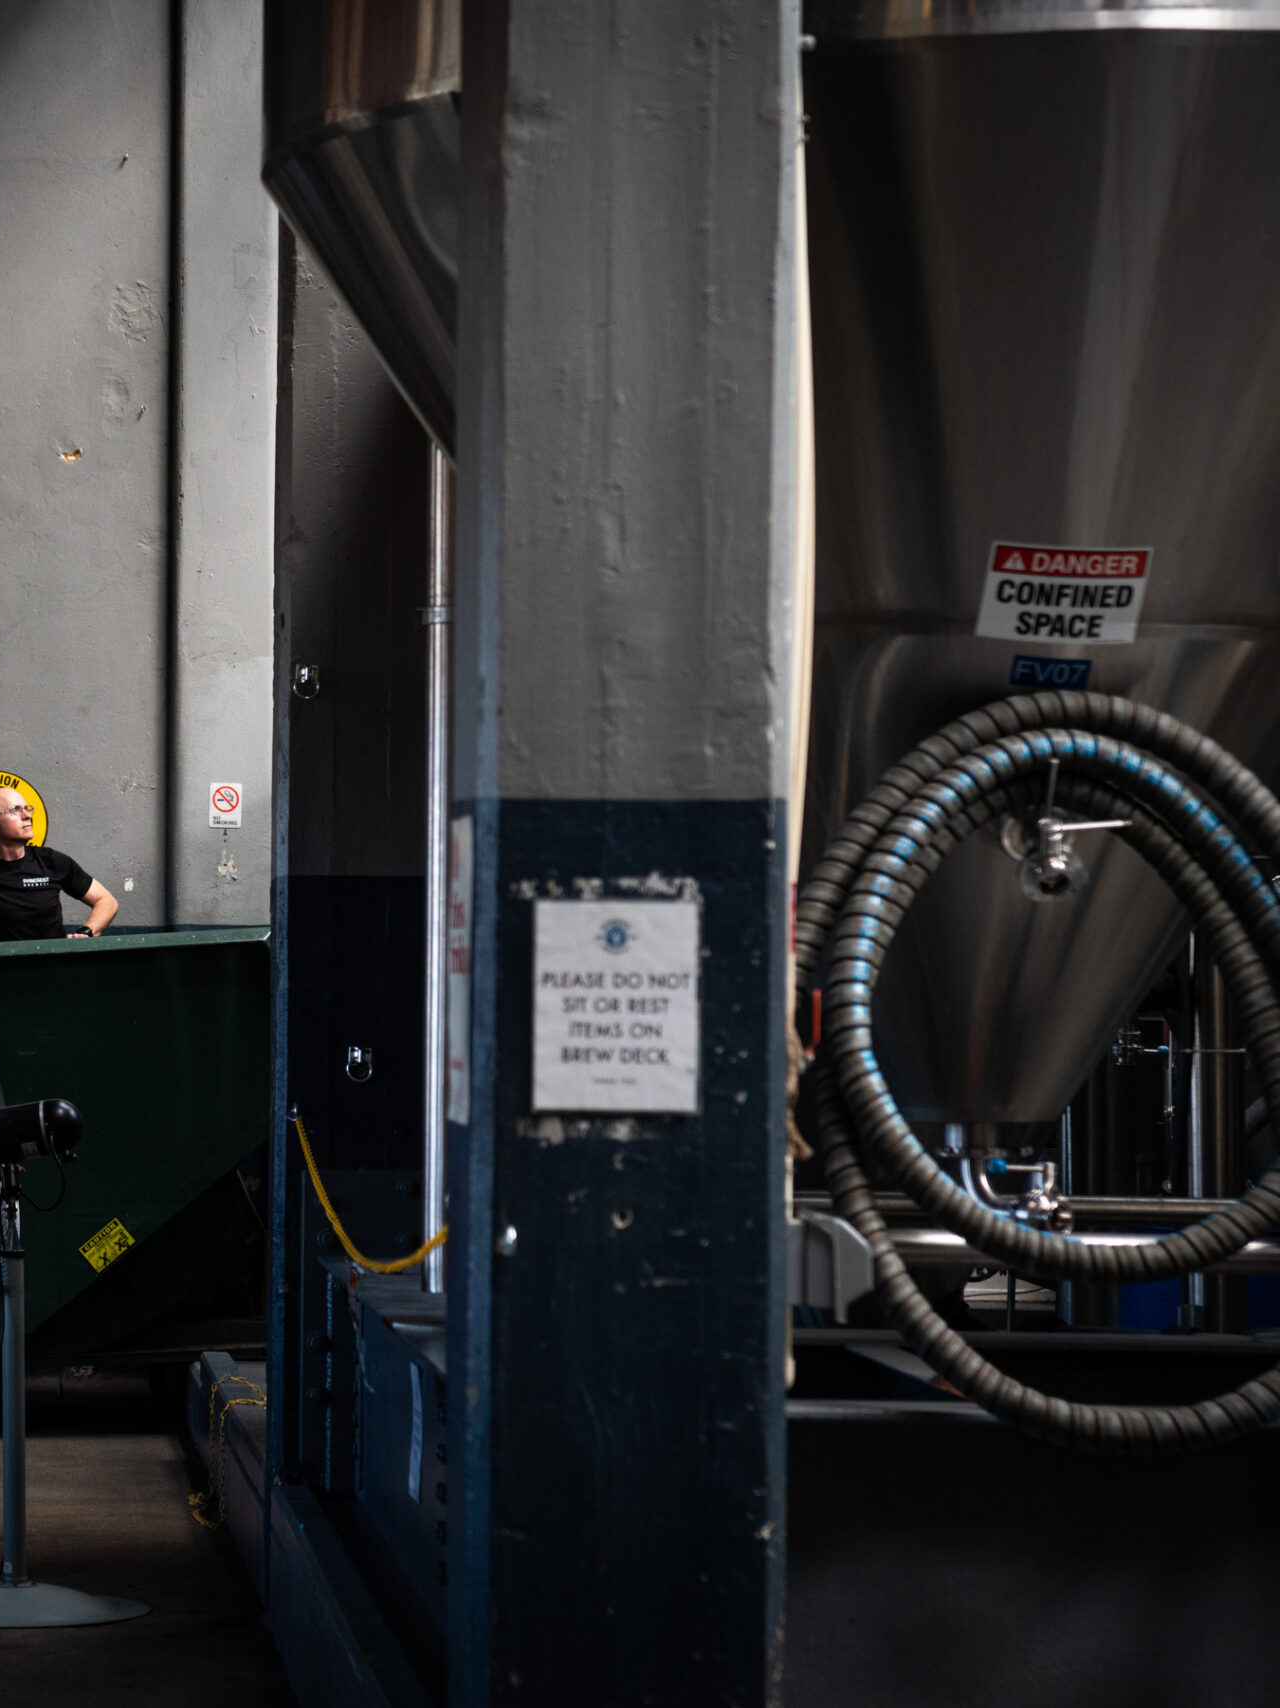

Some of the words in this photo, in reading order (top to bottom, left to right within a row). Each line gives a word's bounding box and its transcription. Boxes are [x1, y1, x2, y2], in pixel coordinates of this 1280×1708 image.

[1030, 552, 1140, 576] DANGER
[997, 579, 1134, 608] CONFINED
[1016, 611, 1105, 638] SPACE
[1014, 660, 1089, 685] FV07
[542, 971, 604, 989] PLEASE
[612, 972, 643, 989] DO
[648, 973, 690, 989] NOT
[563, 997, 587, 1014] SIT
[593, 997, 622, 1014] OR
[627, 998, 669, 1014] REST
[569, 1021, 623, 1039] ITEMS
[629, 1022, 663, 1039] ON
[561, 1046, 615, 1064] BREW
[619, 1047, 669, 1065] DECK
[82, 1222, 117, 1251] CAUTION
